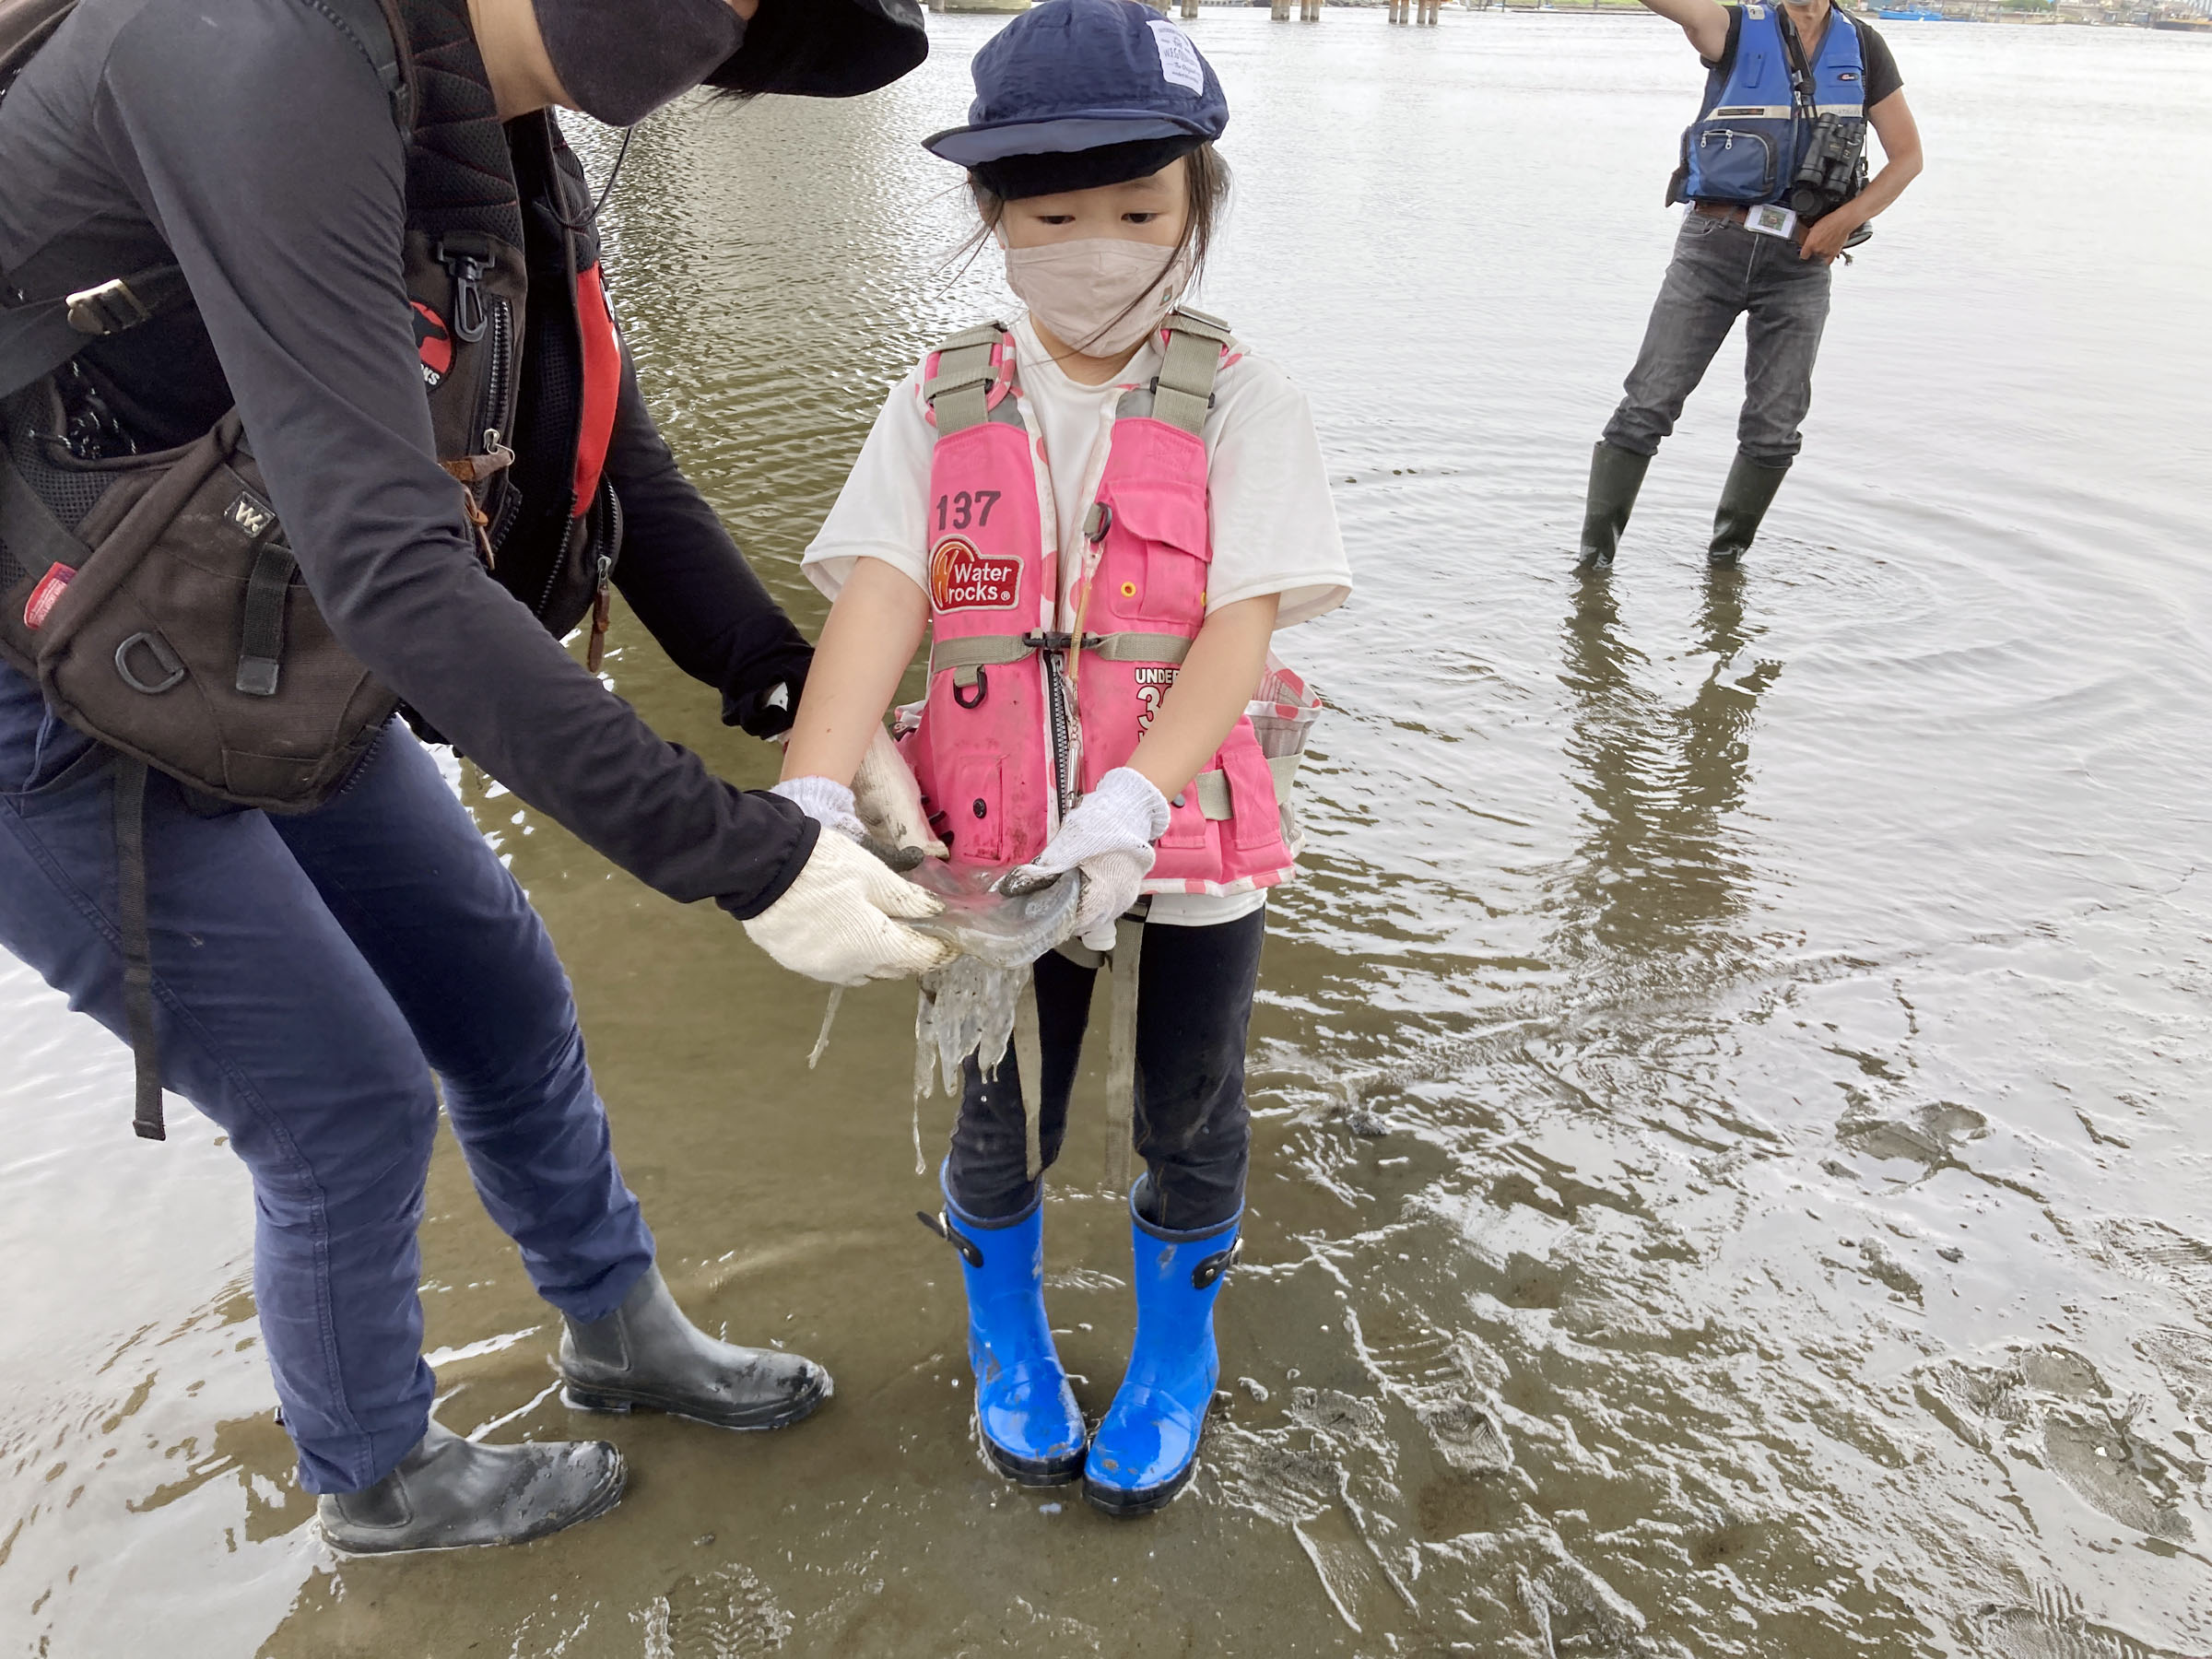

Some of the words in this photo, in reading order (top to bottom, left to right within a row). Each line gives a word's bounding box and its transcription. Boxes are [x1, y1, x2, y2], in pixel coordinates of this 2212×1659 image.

[936, 490, 1001, 531] 137
[954, 562, 1012, 583] Water
[1136, 686, 1171, 730] 3
